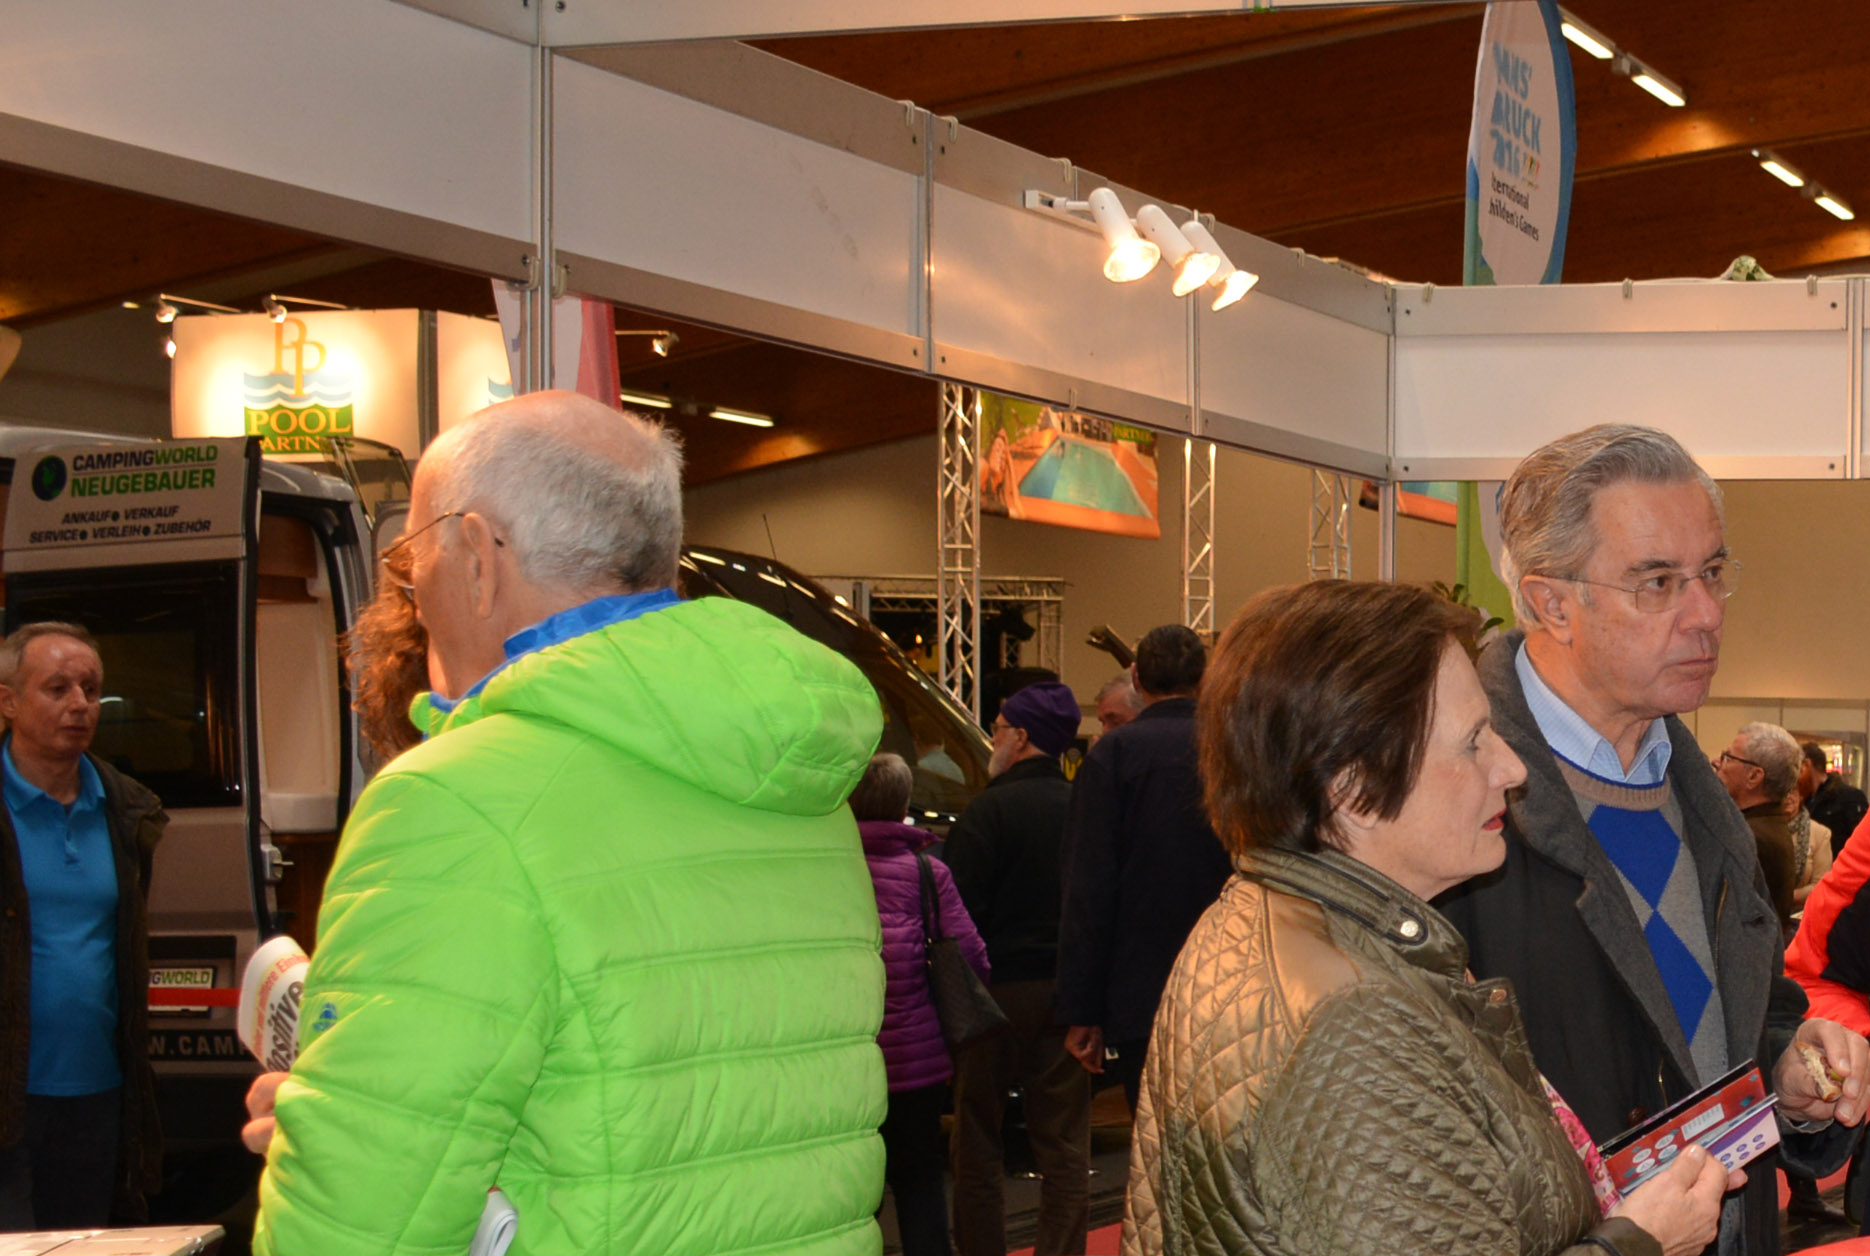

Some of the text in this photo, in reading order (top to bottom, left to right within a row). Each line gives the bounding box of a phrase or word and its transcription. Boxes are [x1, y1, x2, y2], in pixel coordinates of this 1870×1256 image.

[248, 408, 351, 436] POOL
[73, 445, 219, 472] CAMPINGWORLD
[71, 468, 216, 498] NEUGEBAUER
[62, 505, 180, 525] ANKAUF VERKAUF
[29, 520, 211, 544] SERVICE VERLEIH ZUBEHÖR
[150, 971, 211, 985] GWORLD
